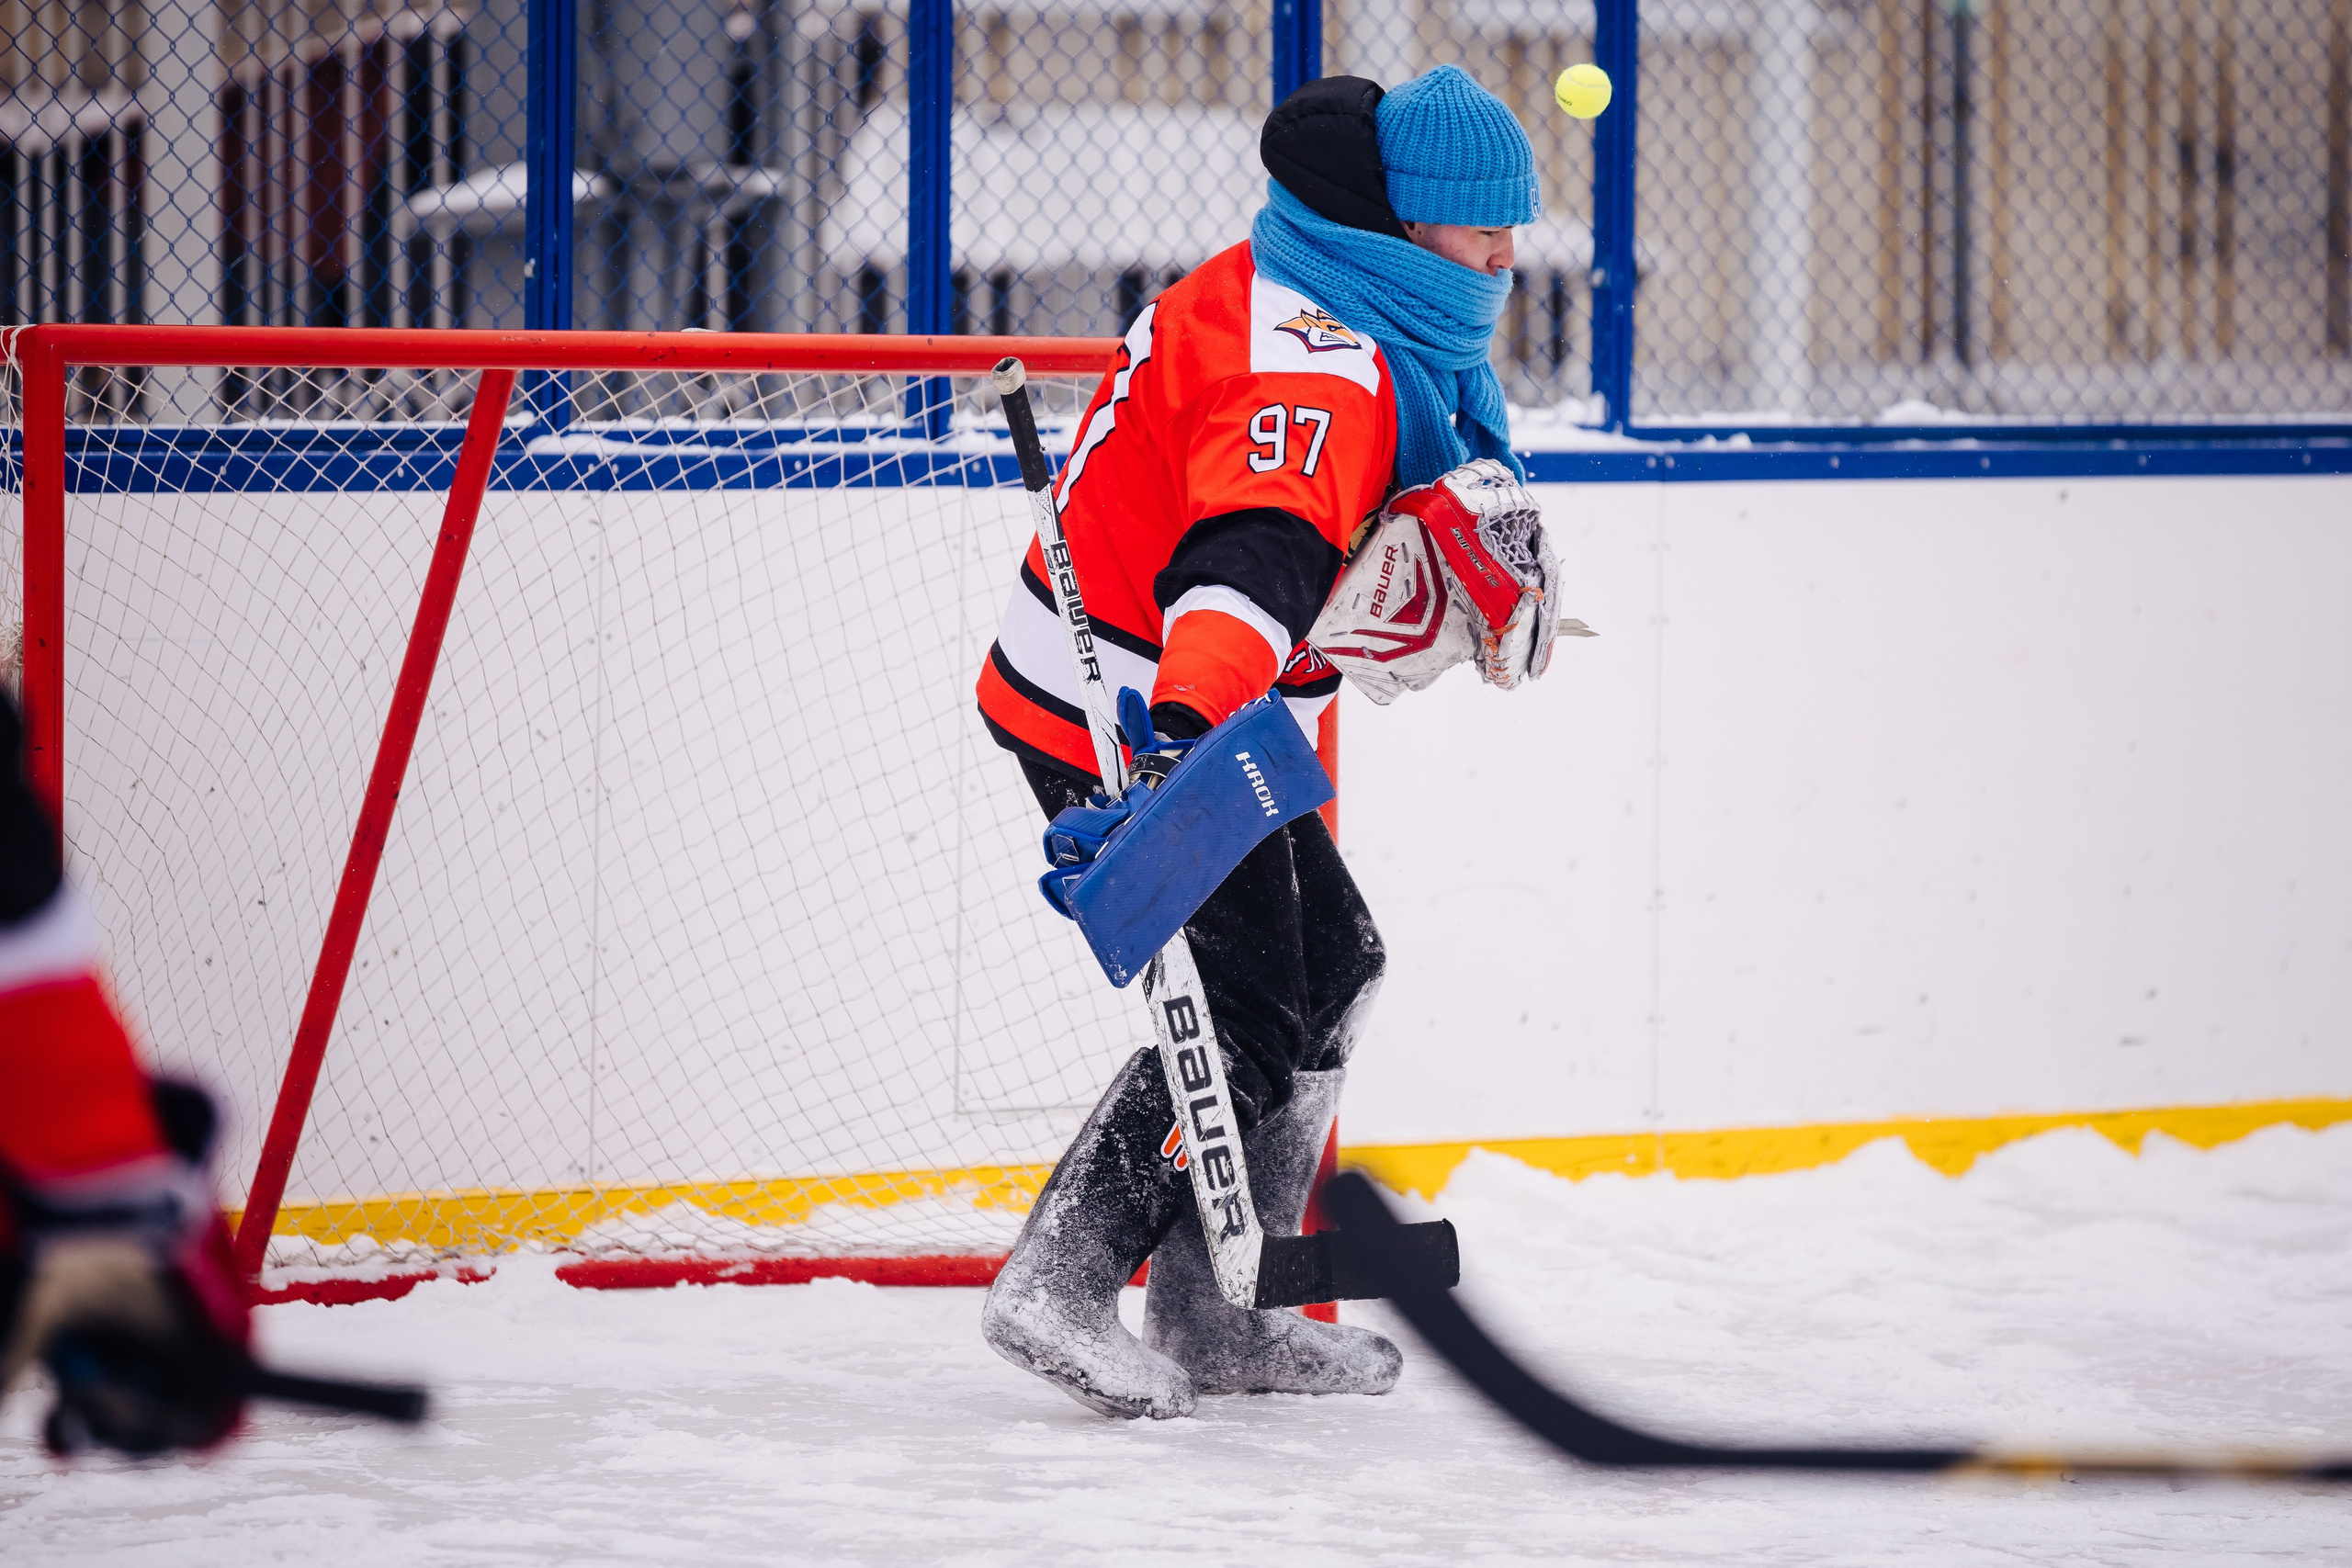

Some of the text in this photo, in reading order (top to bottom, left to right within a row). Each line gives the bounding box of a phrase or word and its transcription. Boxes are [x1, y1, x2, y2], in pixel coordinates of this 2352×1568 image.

[1247, 402, 1332, 478] 97
[1370, 546, 1398, 618] BAUER
[1235, 751, 1279, 817] KROK
[1162, 994, 1246, 1240] BAUER
